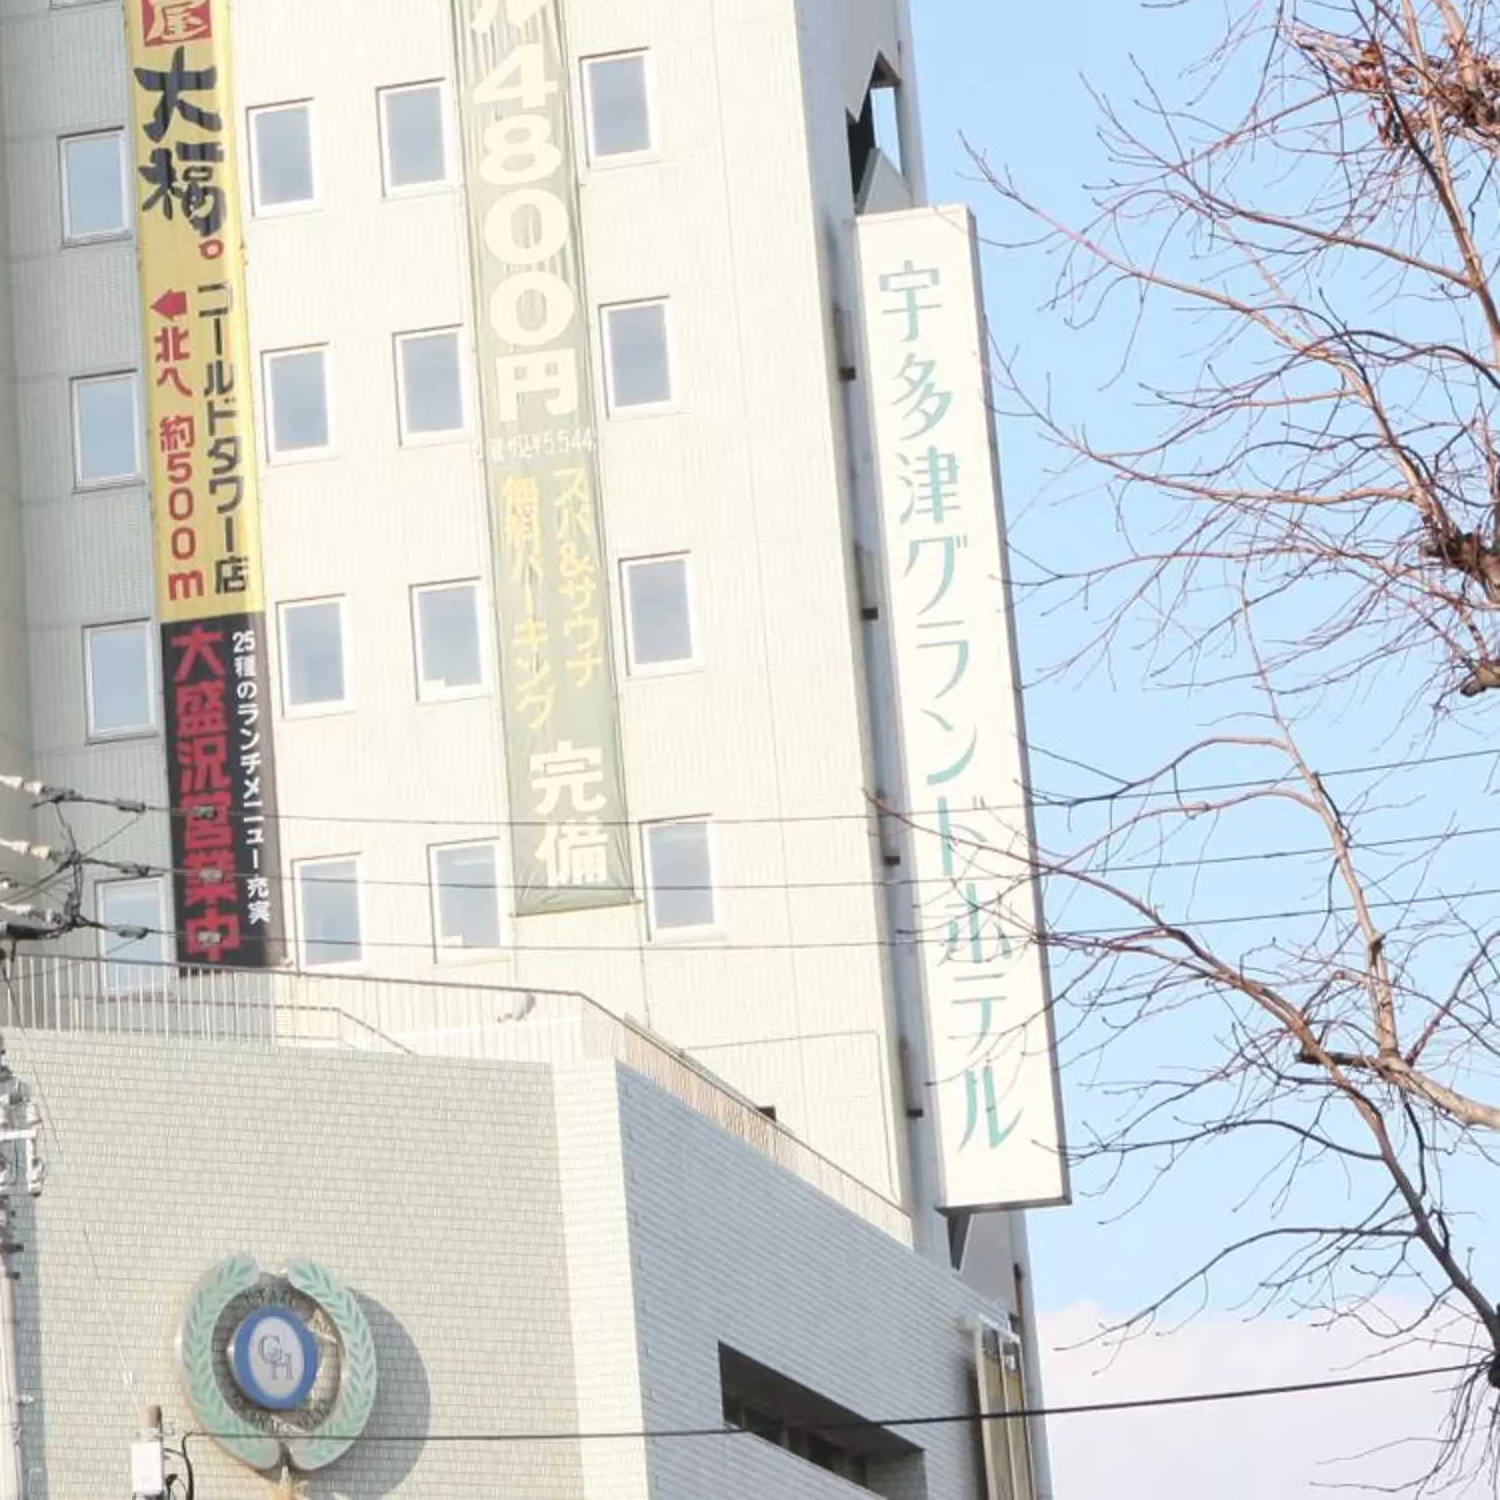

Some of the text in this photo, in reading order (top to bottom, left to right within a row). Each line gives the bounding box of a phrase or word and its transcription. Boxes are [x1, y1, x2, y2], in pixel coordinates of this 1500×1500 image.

[171, 623, 242, 963] 大盛況営業中
[528, 739, 609, 888] 完備
[879, 259, 1023, 1154] 宇多津グランドホテル
